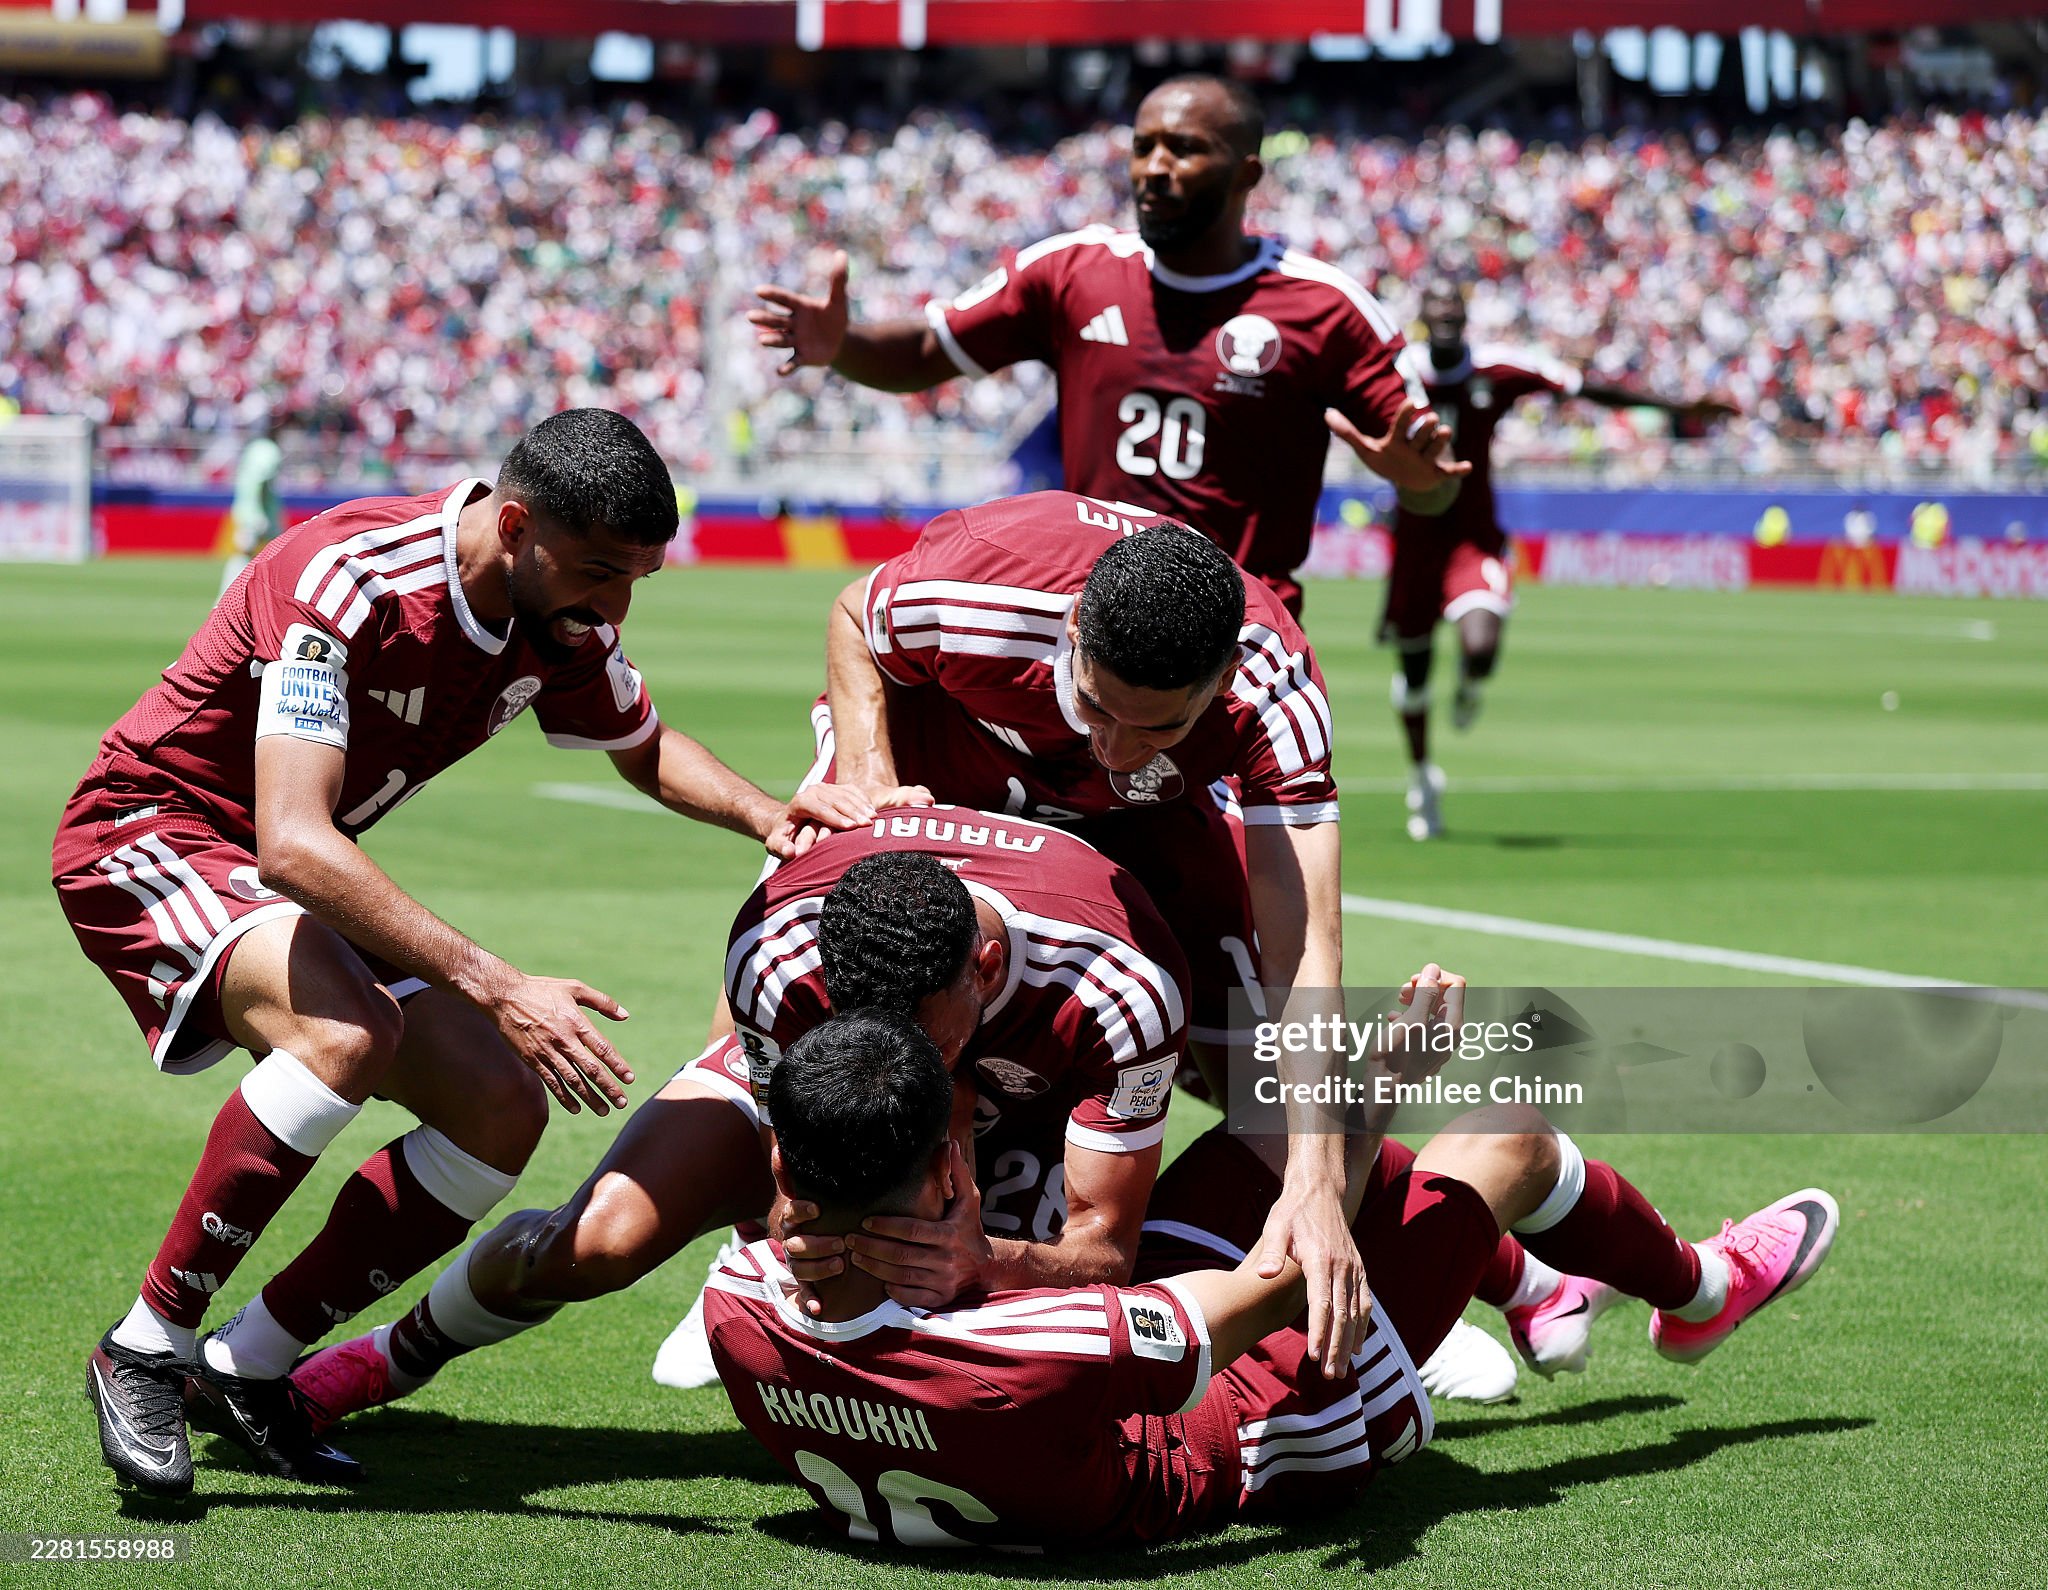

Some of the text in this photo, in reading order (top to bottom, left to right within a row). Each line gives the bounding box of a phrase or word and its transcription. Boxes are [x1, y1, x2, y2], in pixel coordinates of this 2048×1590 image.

[1116, 392, 1206, 480] 20
[282, 667, 338, 687] FOOTBALL
[281, 680, 339, 705] UNITES
[276, 698, 342, 724] the World
[296, 718, 321, 731] FIFA
[1126, 789, 1161, 802] QFA
[202, 1211, 252, 1247] QFA
[756, 1381, 938, 1451] KHOUKHI
